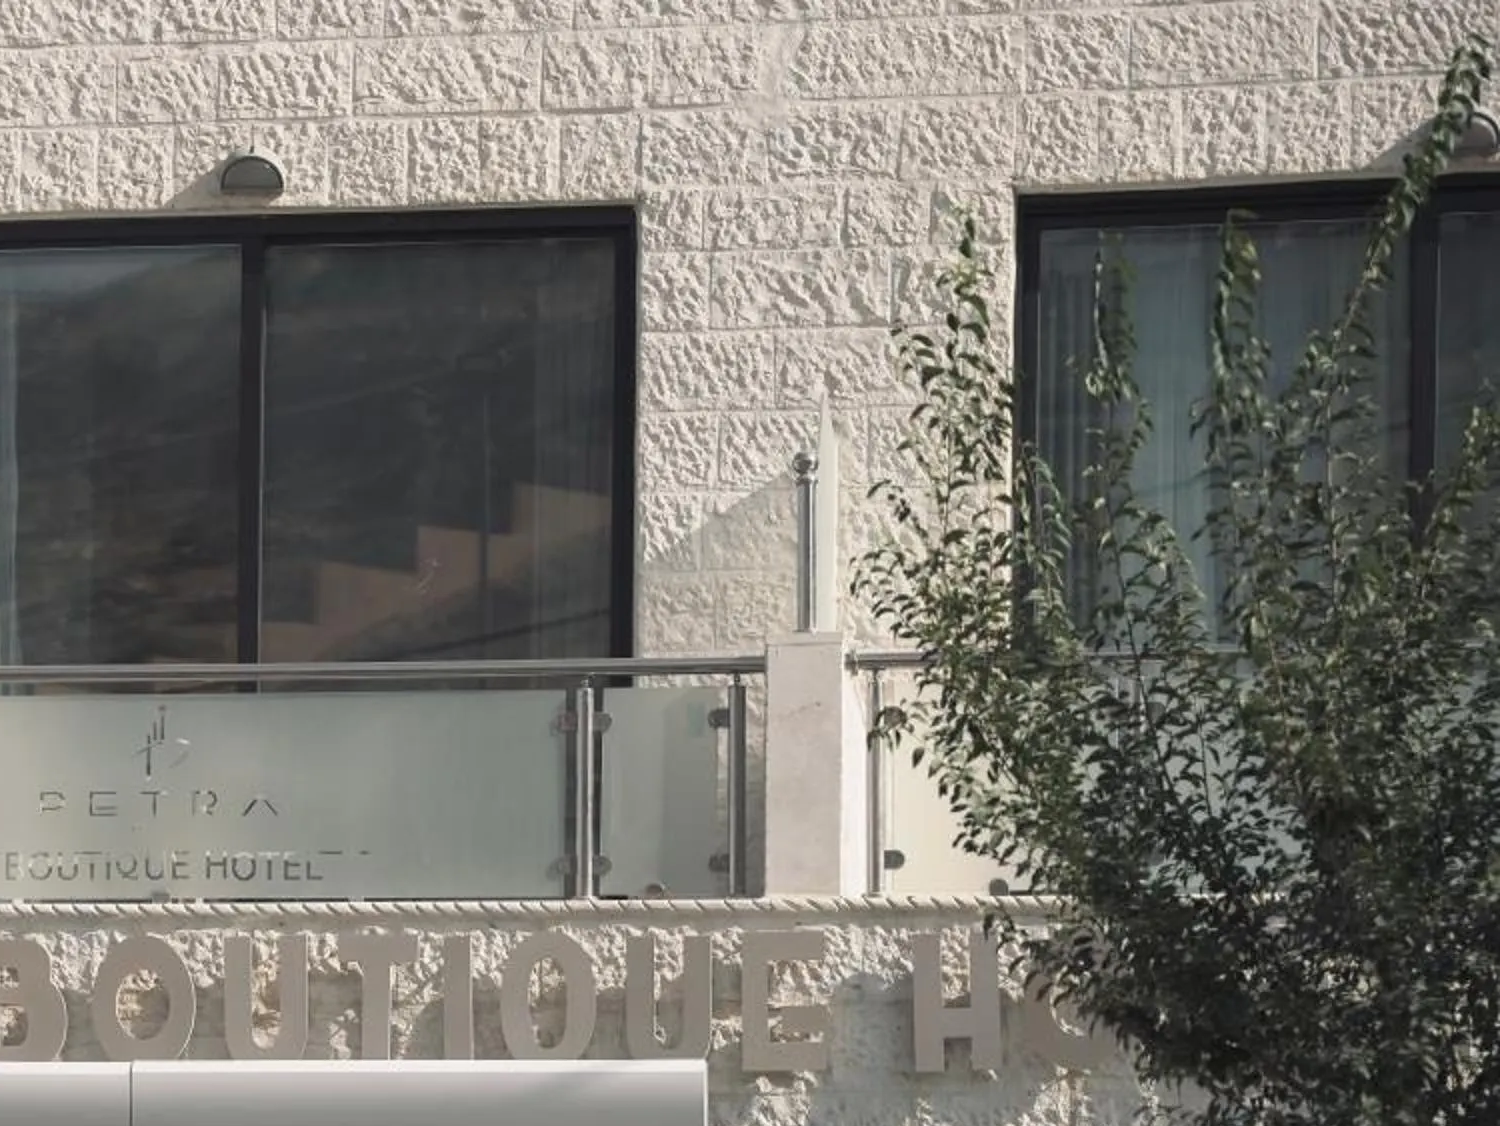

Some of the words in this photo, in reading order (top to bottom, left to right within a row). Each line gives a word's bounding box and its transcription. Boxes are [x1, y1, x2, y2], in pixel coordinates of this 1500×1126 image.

[38, 791, 280, 816] PETRA
[5, 851, 191, 882] BOUTIQUE
[204, 850, 325, 882] HOTEL
